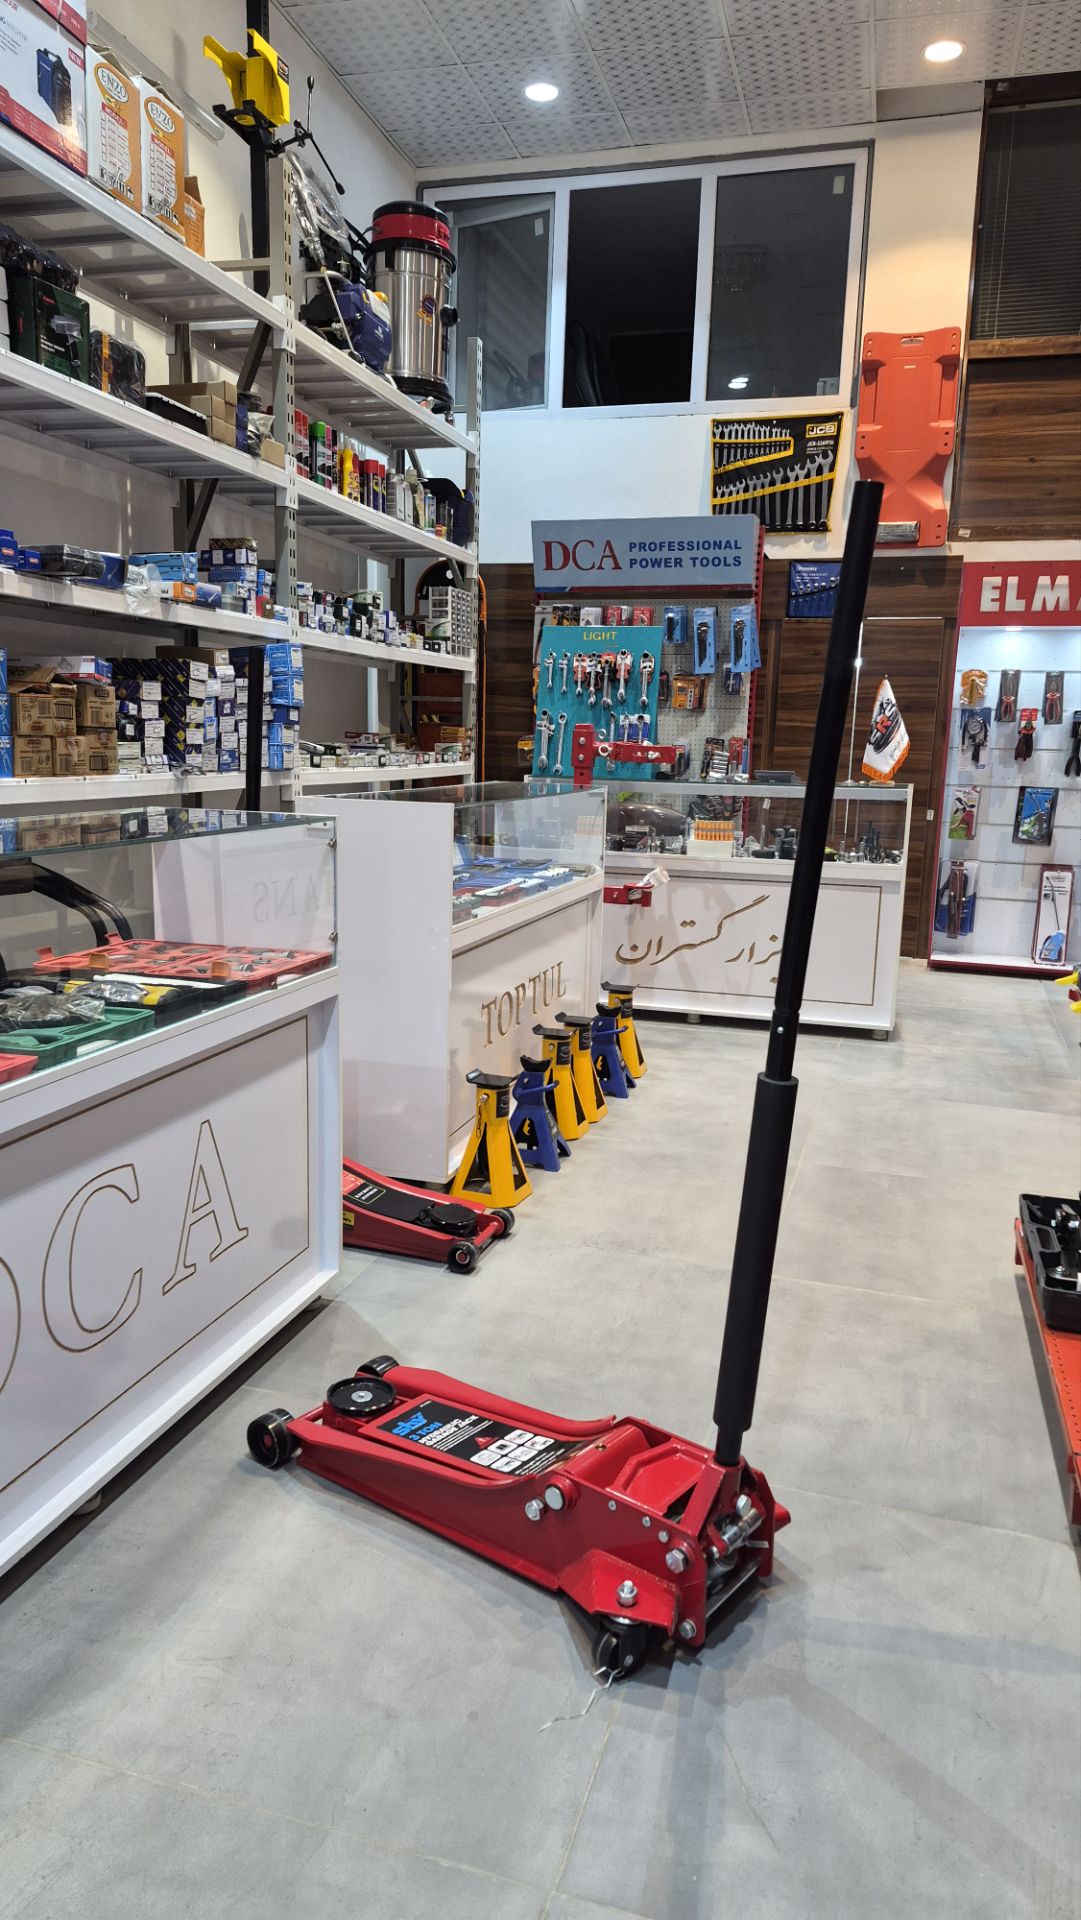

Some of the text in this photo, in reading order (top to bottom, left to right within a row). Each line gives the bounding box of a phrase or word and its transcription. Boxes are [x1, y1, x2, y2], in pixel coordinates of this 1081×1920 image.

[69, 50, 82, 65] NEW
[101, 69, 127, 98] ENZO
[150, 103, 174, 130] ENZO
[808, 425, 835, 435] JCB
[541, 539, 622, 571] DCA
[629, 539, 742, 553] PROFESSIONAL
[629, 556, 742, 569] POWER TOOLS
[979, 575, 1081, 612] ELM
[583, 631, 617, 640] LIGHT
[615, 894, 771, 966] گستران
[481, 961, 567, 1048] TOPTUL
[0, 1119, 249, 1393] CA
[416, 1421, 443, 1435] TON
